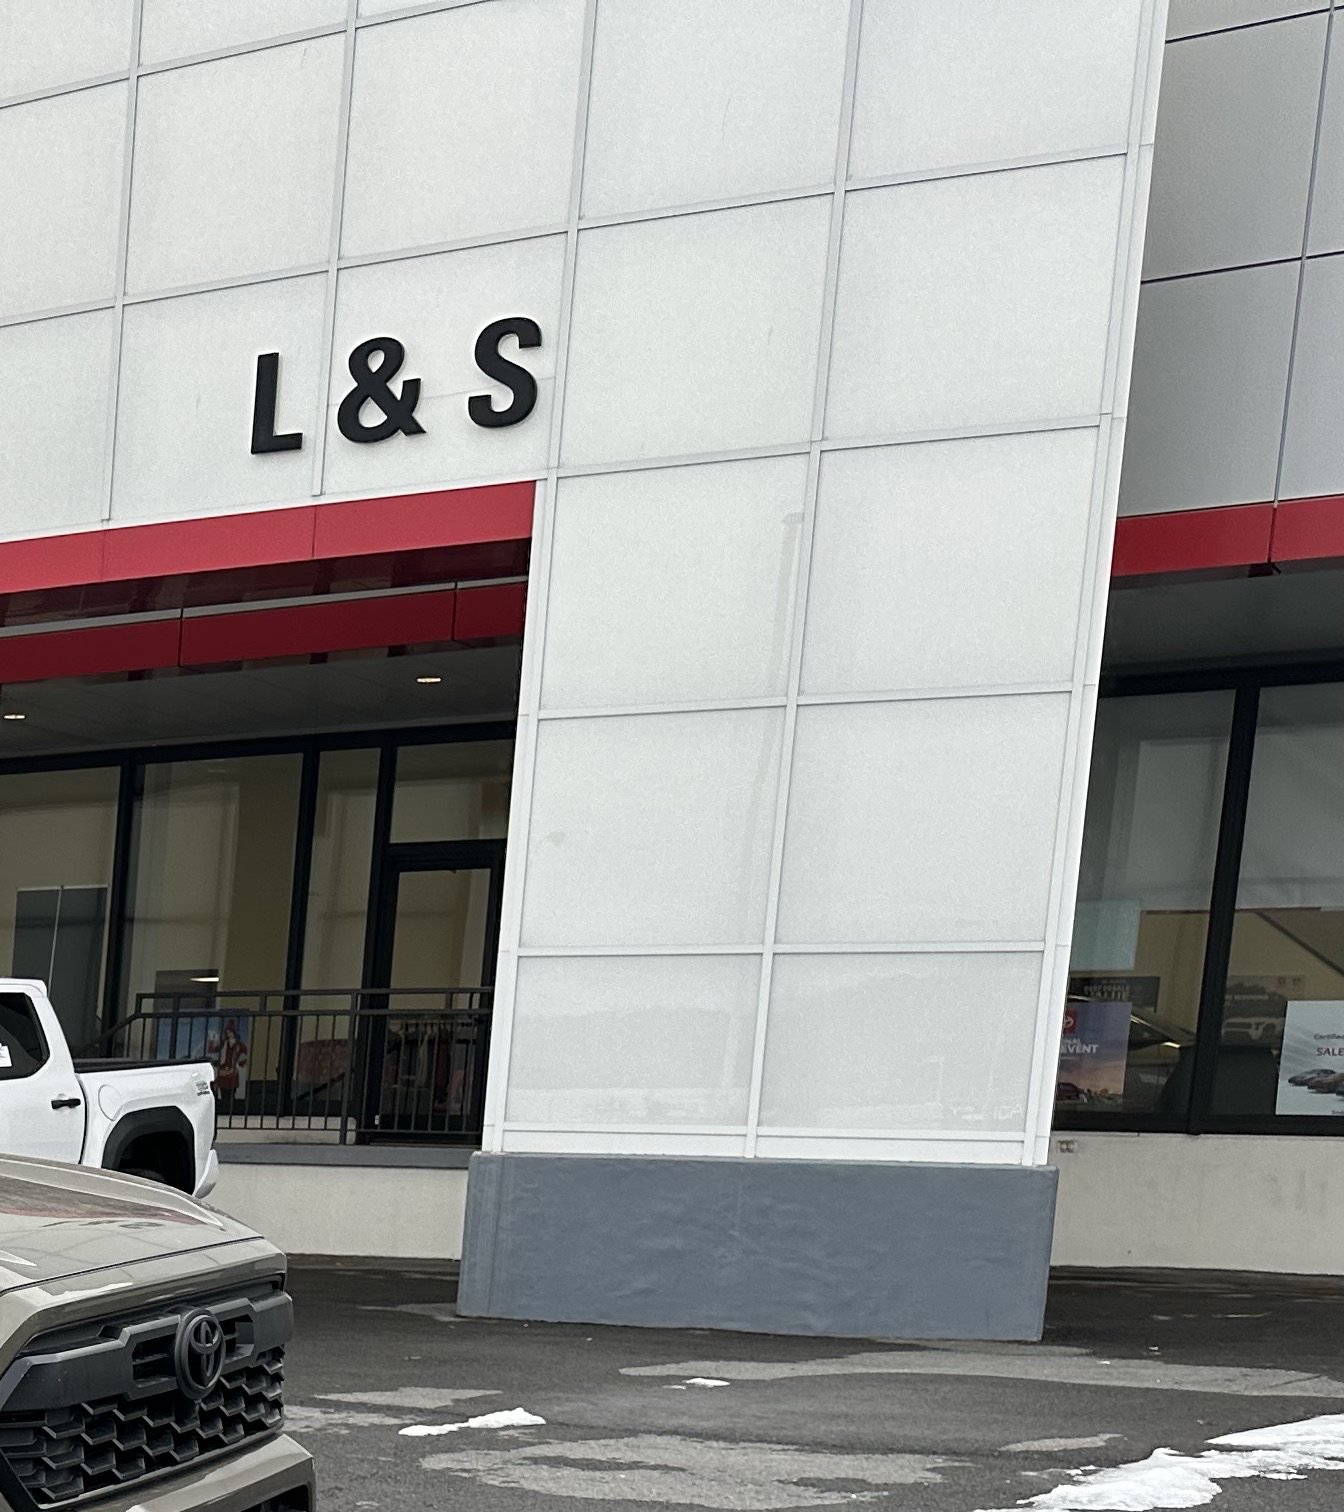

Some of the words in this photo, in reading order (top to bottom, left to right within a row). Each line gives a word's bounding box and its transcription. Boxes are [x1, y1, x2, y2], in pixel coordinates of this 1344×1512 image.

[251, 352, 303, 454] L
[337, 337, 427, 443] &
[468, 317, 542, 428] S
